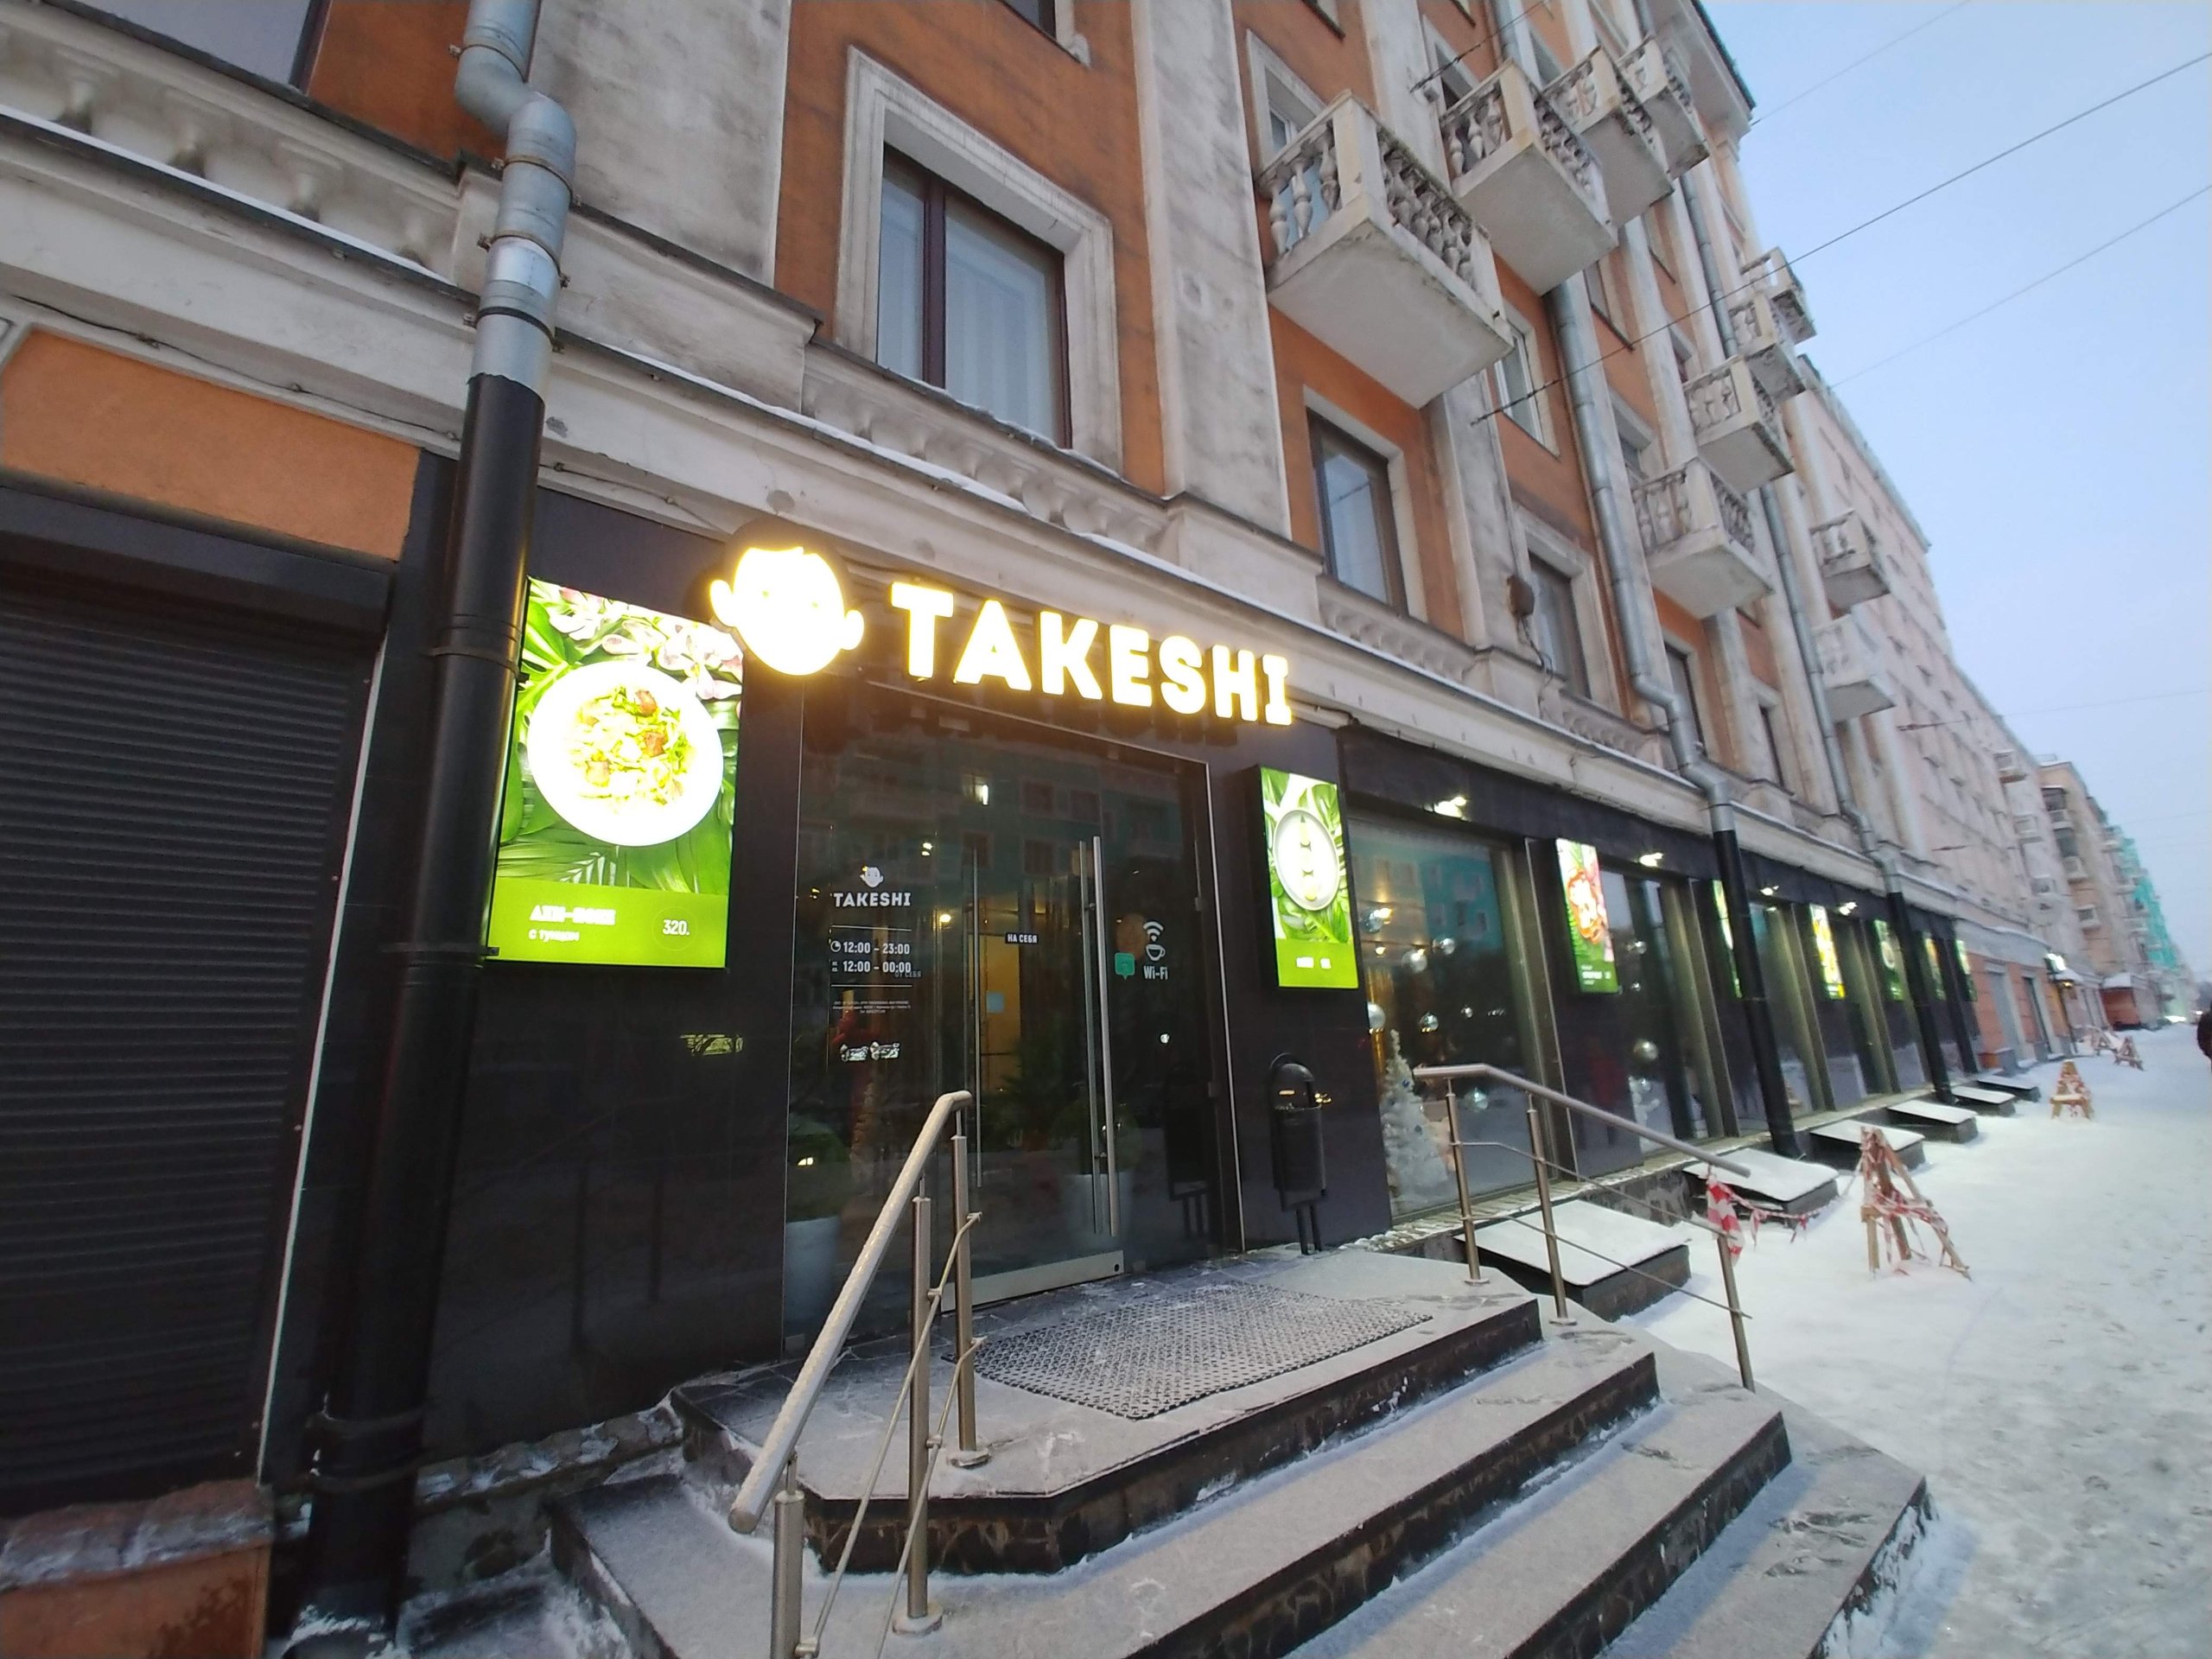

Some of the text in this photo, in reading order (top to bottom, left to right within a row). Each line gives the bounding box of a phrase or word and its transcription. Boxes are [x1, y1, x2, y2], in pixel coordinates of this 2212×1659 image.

[890, 581, 1293, 726] TAKESHI
[833, 892, 912, 907] TAKESHI
[1007, 933, 1038, 944] НА СЕБЯ
[842, 941, 871, 954] 12:00
[882, 943, 910, 955] 23:00
[842, 960, 871, 973] 12:00
[882, 961, 912, 973] 00:00
[1143, 965, 1168, 981] Wi-Fi
